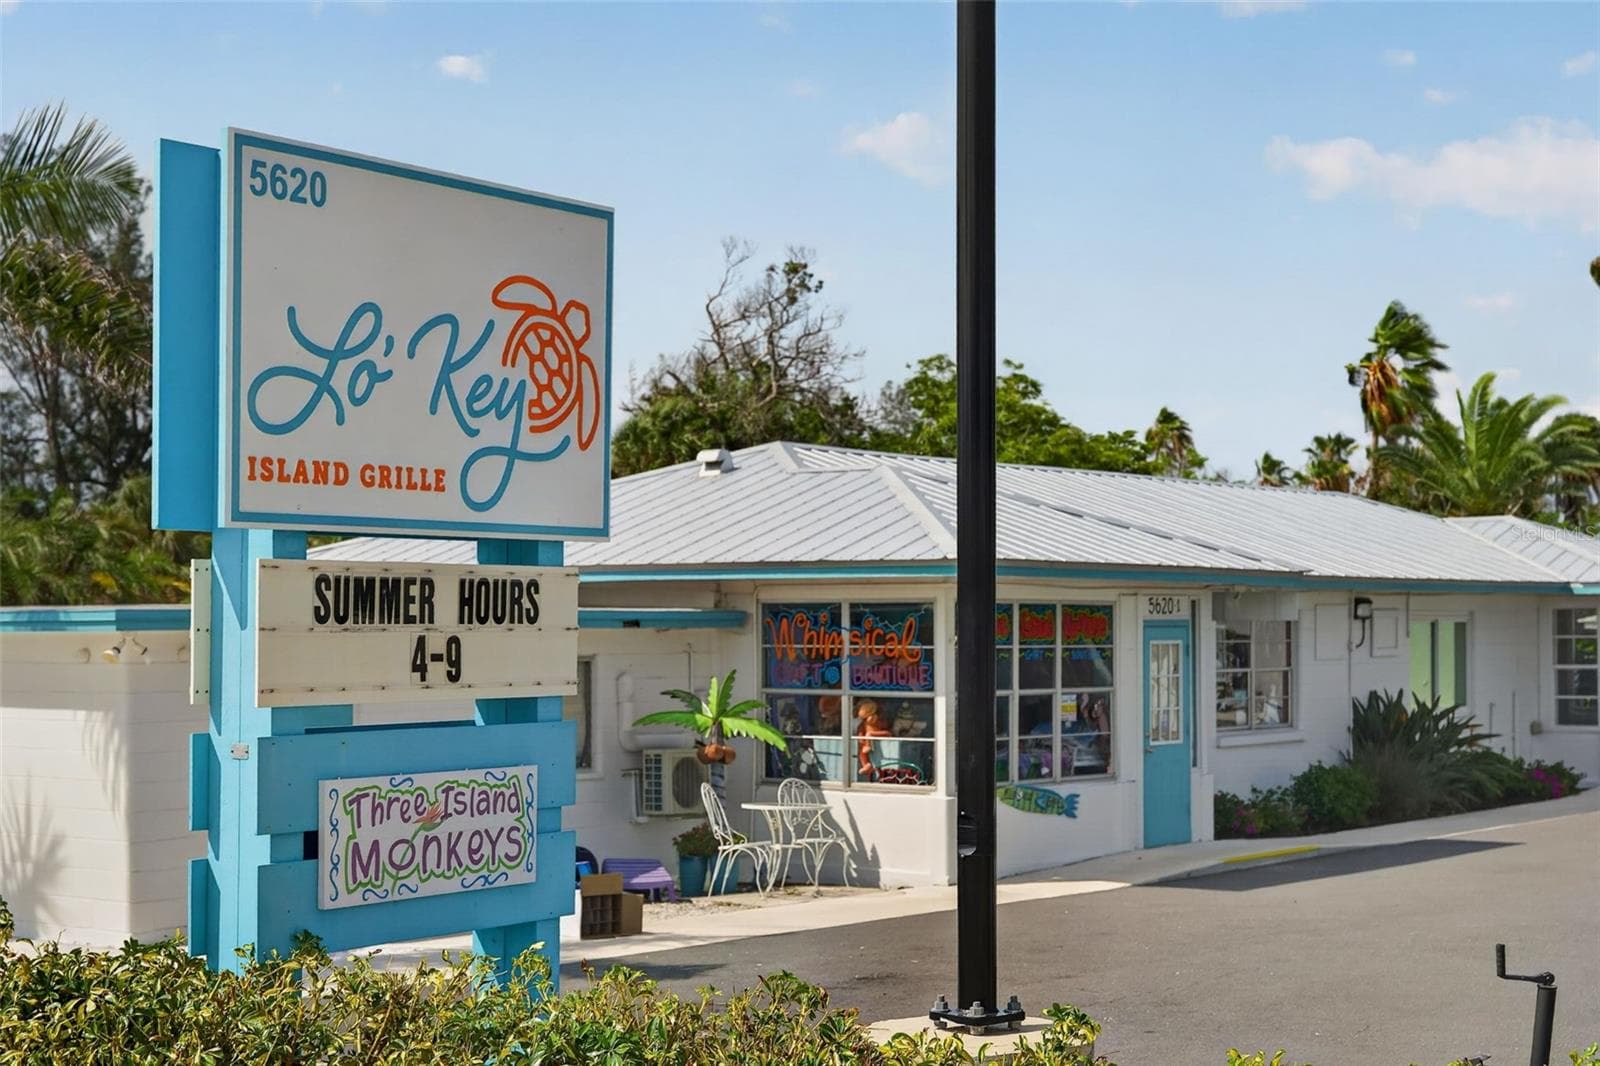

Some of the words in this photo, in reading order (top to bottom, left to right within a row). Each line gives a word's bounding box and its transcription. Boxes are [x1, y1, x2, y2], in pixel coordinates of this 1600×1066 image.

[249, 159, 327, 208] 5620
[247, 301, 394, 436] Lo'
[407, 313, 571, 513] Key
[247, 455, 350, 487] ISLAND
[359, 466, 447, 493] GRILLE
[314, 573, 435, 626] SUMMER
[458, 577, 541, 626] HOURS
[411, 633, 463, 684] 4-9
[765, 611, 922, 662] Whimsical
[348, 791, 427, 829] Three
[440, 782, 522, 821] Island
